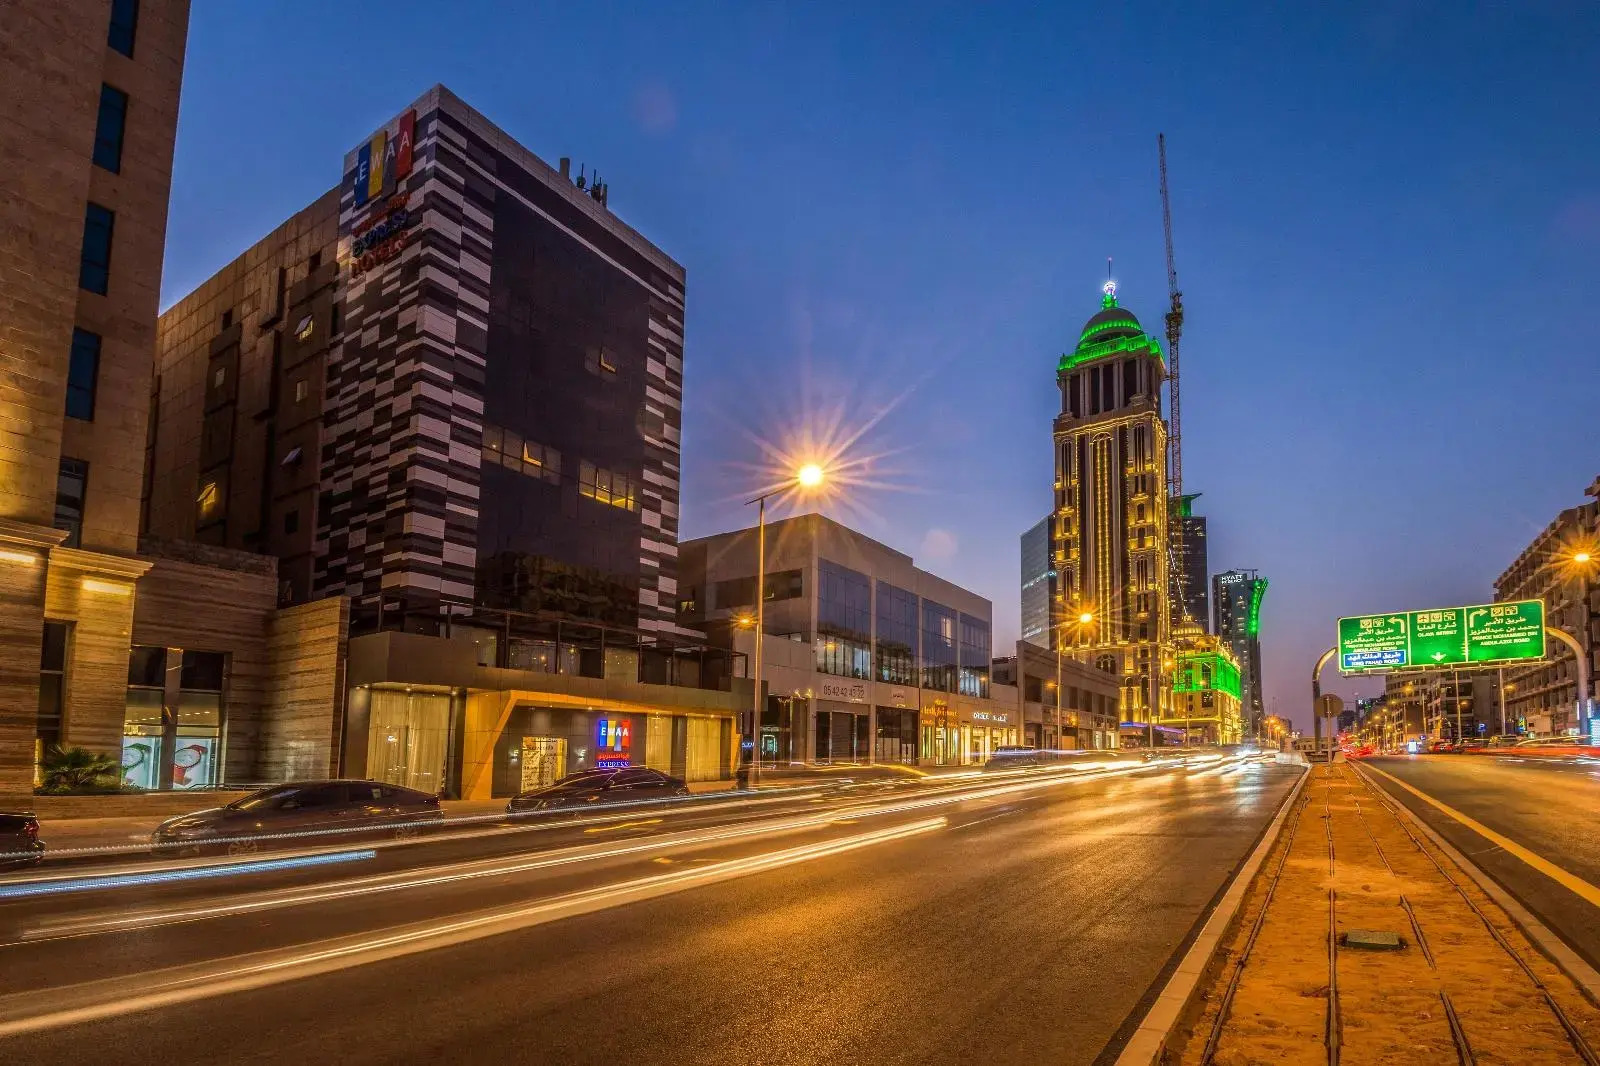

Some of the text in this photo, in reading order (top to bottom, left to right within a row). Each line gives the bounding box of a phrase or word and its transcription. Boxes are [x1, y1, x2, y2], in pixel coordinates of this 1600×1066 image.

[360, 131, 410, 182] EWAA
[1437, 622, 1457, 630] شارع
[1375, 627, 1394, 635] طريق
[601, 727, 629, 736] EWAA
